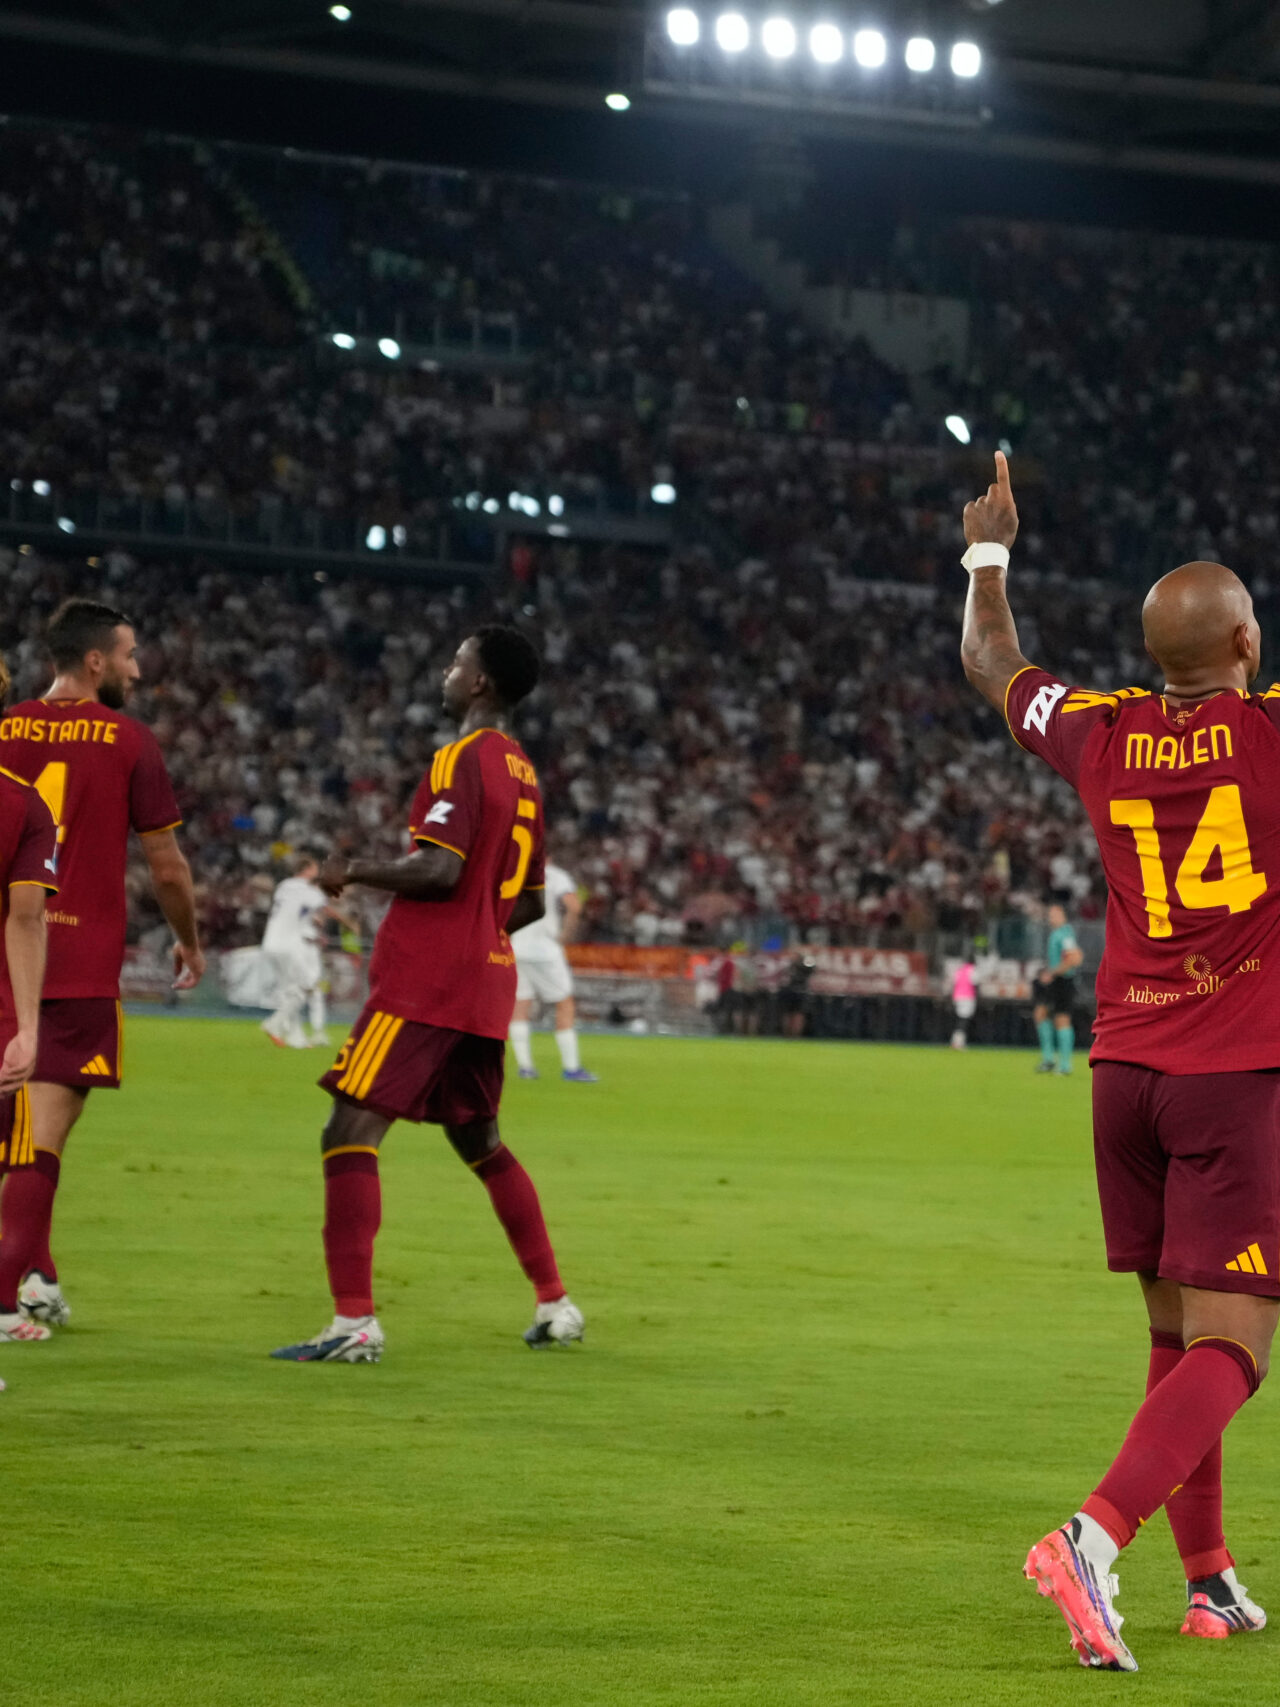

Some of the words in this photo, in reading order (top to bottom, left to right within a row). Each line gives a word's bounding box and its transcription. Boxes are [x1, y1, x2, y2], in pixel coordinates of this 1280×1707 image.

[0, 717, 118, 744] CRISTANTE
[1125, 724, 1233, 769] MALEN
[1110, 784, 1267, 938] 14
[1124, 985, 1180, 1005] Auberg
